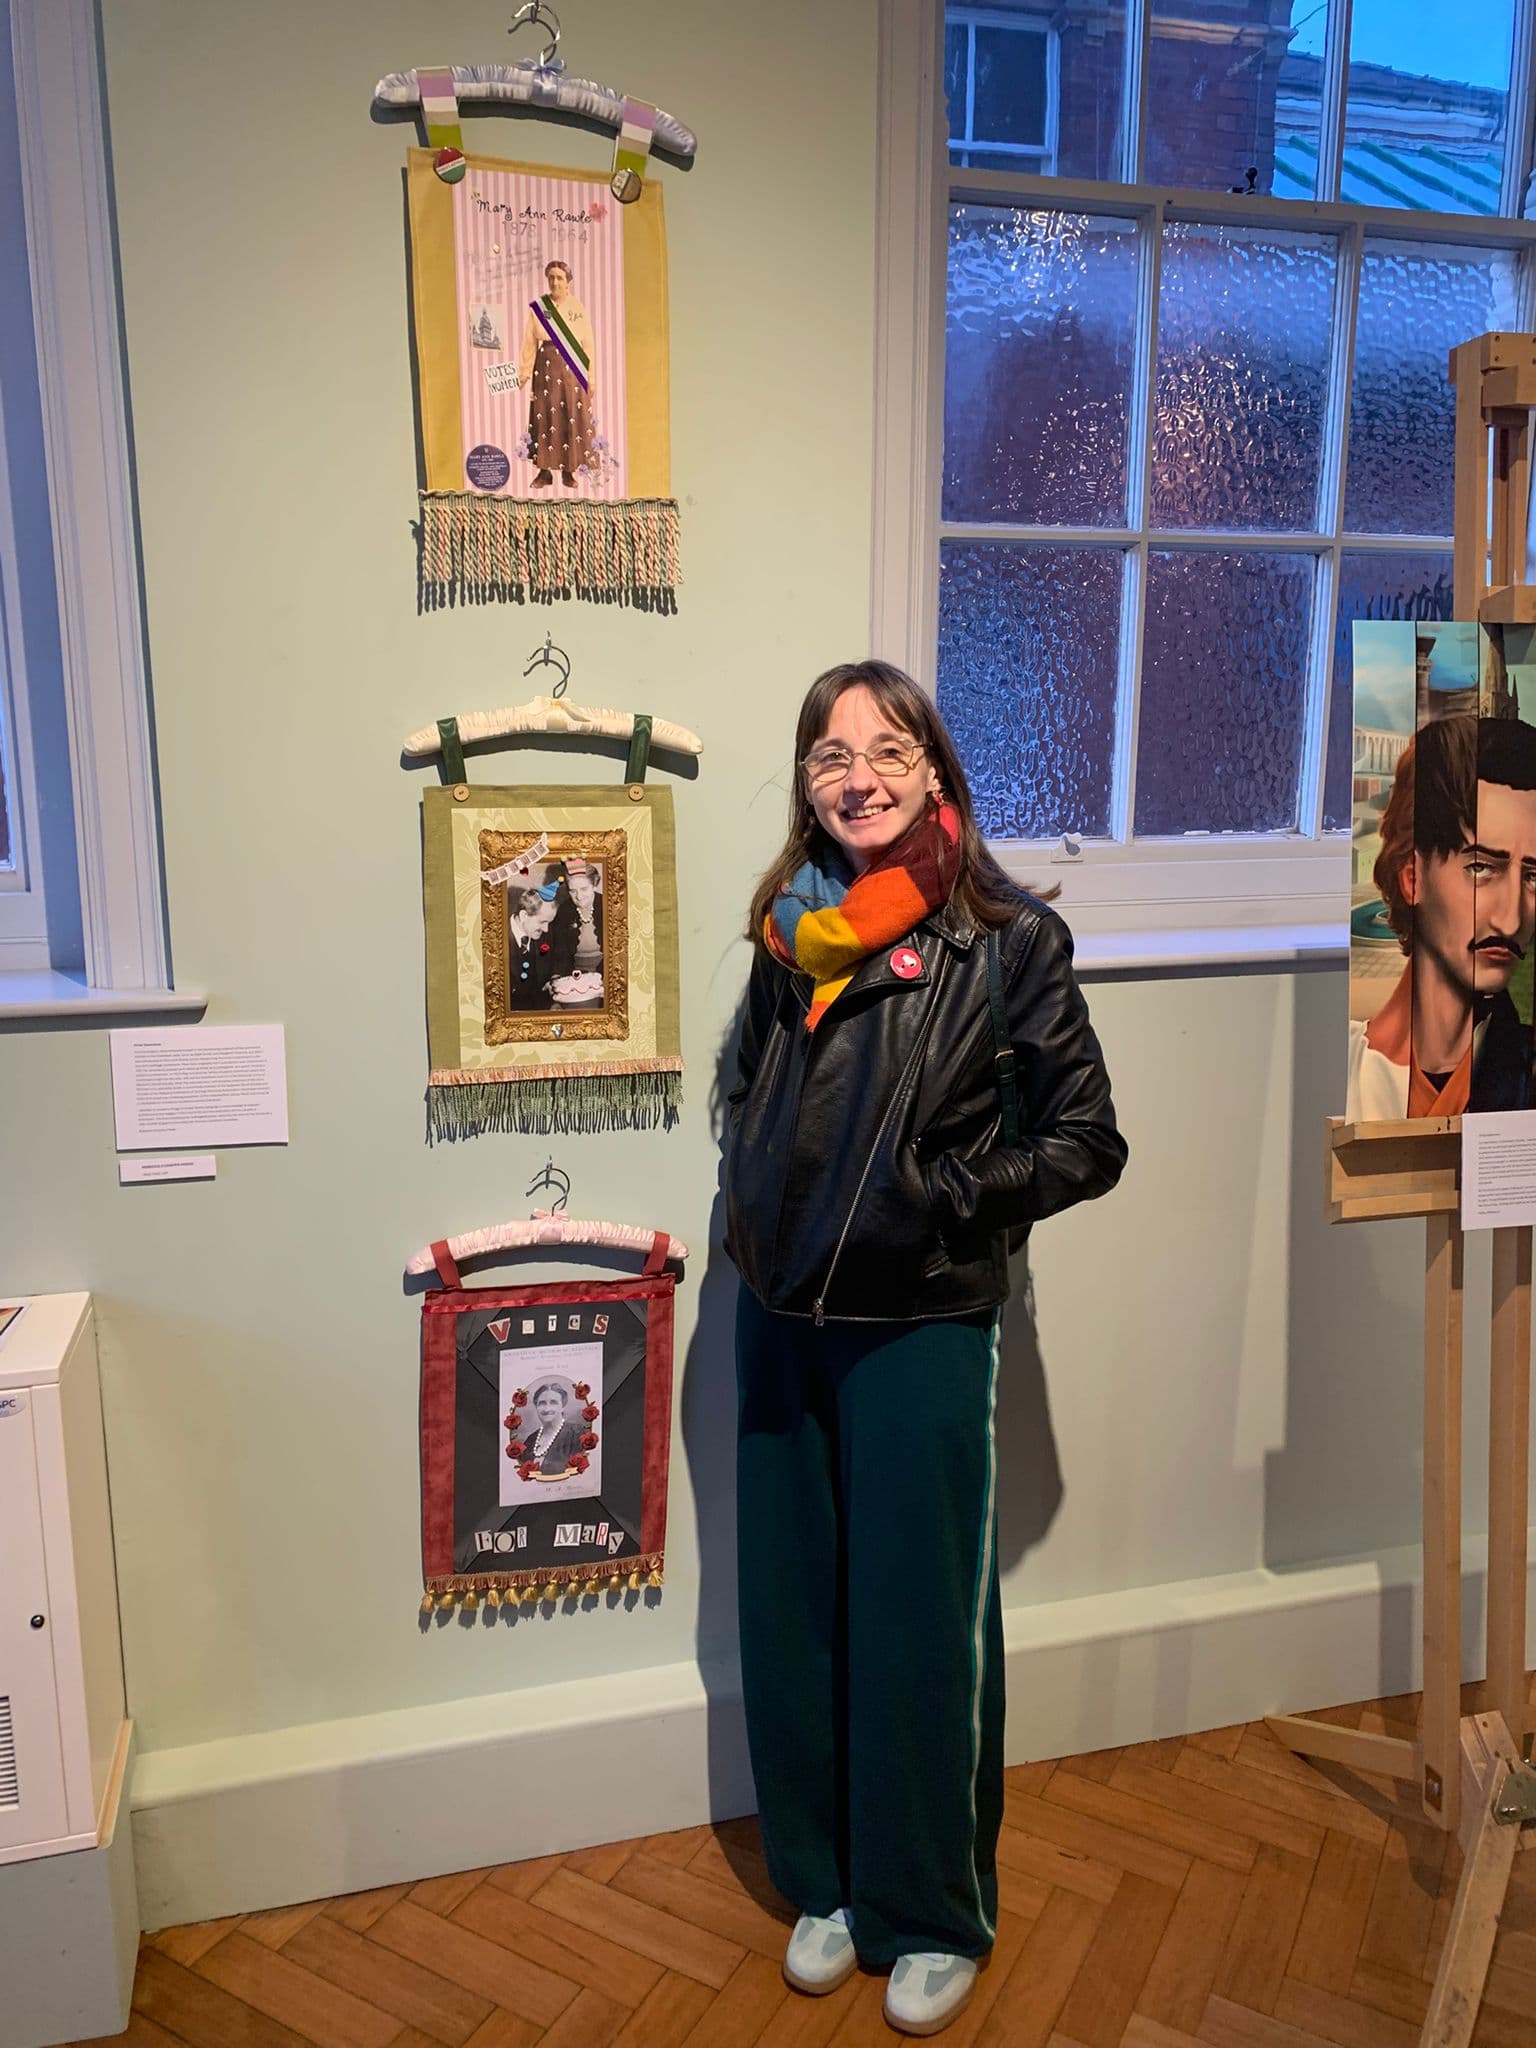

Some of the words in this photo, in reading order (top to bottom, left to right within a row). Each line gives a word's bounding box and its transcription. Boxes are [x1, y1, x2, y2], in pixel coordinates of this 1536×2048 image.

[477, 199, 512, 221] Mary
[519, 206, 547, 220] Ann
[552, 208, 593, 223] Rawle
[484, 362, 516, 379] VOTES
[488, 377, 520, 393] WOMEN
[475, 1526, 526, 1552] FOR
